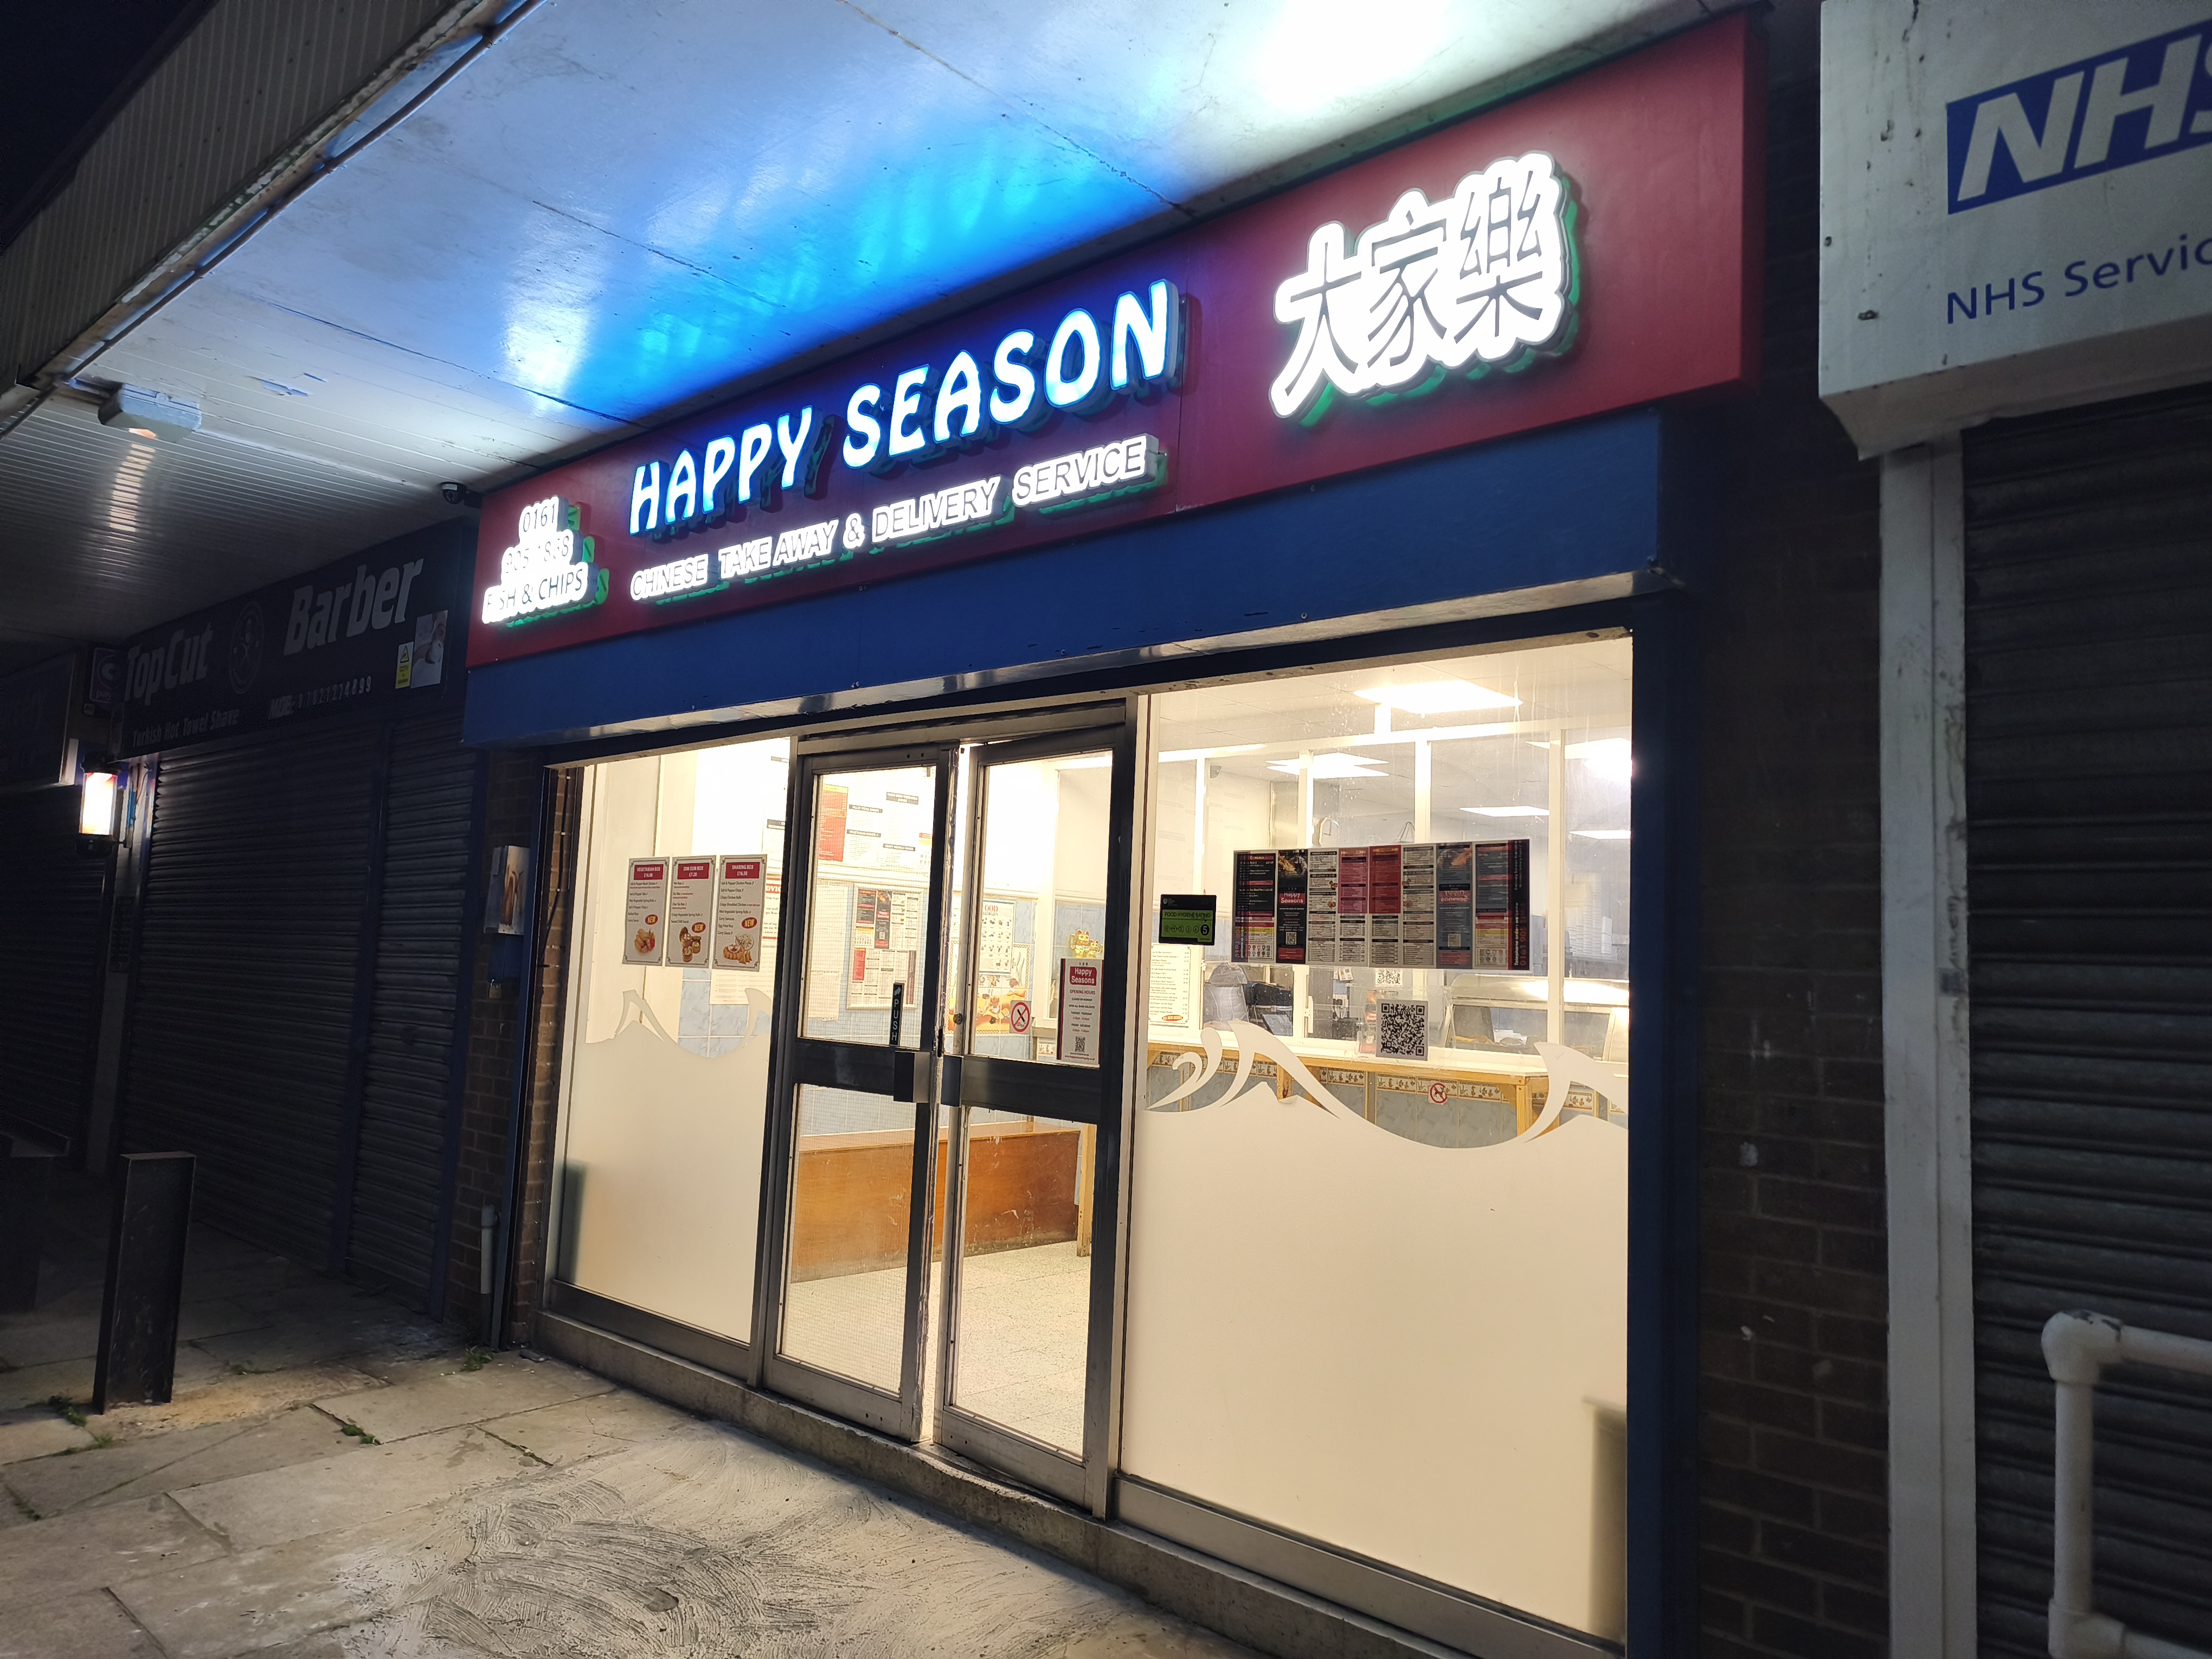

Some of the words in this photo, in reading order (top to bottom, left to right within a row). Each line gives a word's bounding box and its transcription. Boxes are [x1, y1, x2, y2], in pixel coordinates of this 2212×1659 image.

[1958, 34, 2212, 201] NH
[1278, 162, 1552, 404] 大家樂
[1947, 271, 2046, 325] NHS
[2065, 234, 2212, 298] Servic
[629, 405, 813, 535] HAPPY
[843, 278, 1169, 469] SEASON
[522, 500, 557, 535] 0161
[631, 556, 707, 600] CHINESE
[718, 537, 771, 580] TAKE
[773, 518, 839, 567] AWAY
[844, 513, 864, 549] &
[872, 476, 1001, 543] DELIVERY
[1012, 434, 1148, 507] SERVICE
[486, 587, 517, 613] FSH
[521, 583, 533, 605] &
[538, 568, 583, 601] CHIPS
[125, 622, 214, 706] TopCut
[283, 558, 424, 656] Barber
[132, 722, 162, 748] Turkish
[164, 719, 180, 740] Hot
[183, 712, 208, 736] Towel
[209, 709, 240, 731] Shave
[744, 919, 755, 927] NEW
[1202, 925, 1208, 934] 5
[1071, 976, 1095, 984] Seasons
[1075, 967, 1092, 976] Happy
[891, 999, 899, 1041] PUSH
